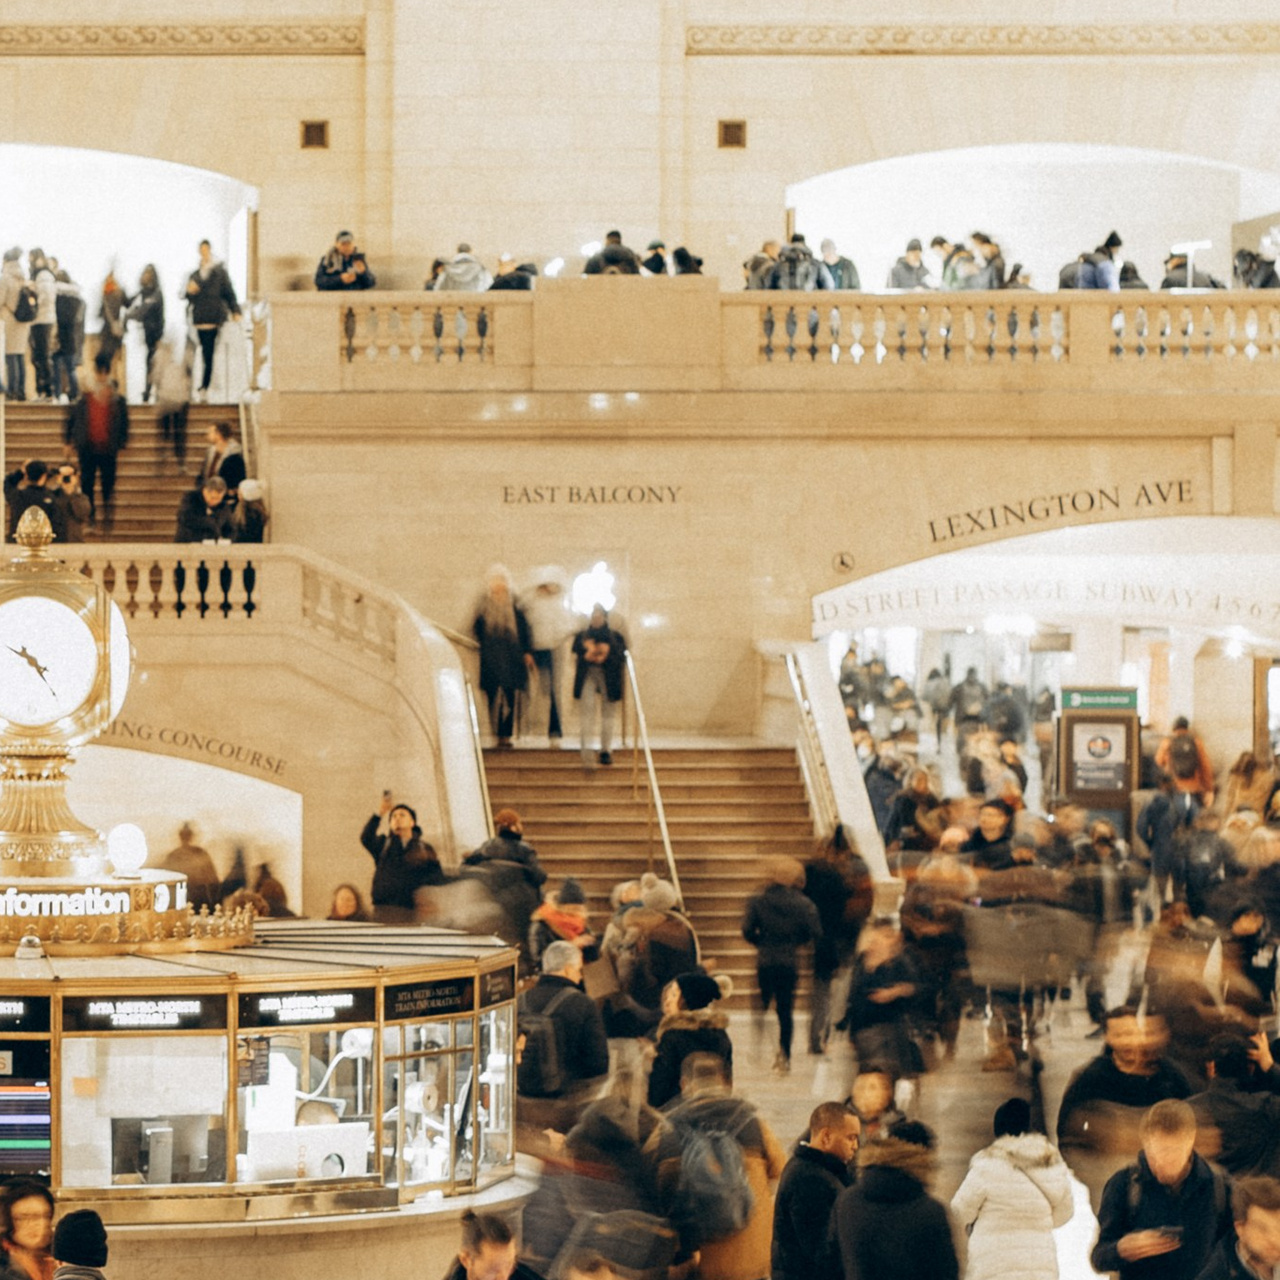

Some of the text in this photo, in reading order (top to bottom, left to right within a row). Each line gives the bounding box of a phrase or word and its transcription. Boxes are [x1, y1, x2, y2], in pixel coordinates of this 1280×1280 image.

[503, 486, 681, 504] EAST BALCONY
[929, 480, 1194, 543] LEXINGTON AVE
[846, 587, 941, 617] STREET
[955, 579, 1067, 604] PASSAGE
[1086, 581, 1200, 608] SUBWAY
[102, 721, 288, 776] ING CONCOURSE
